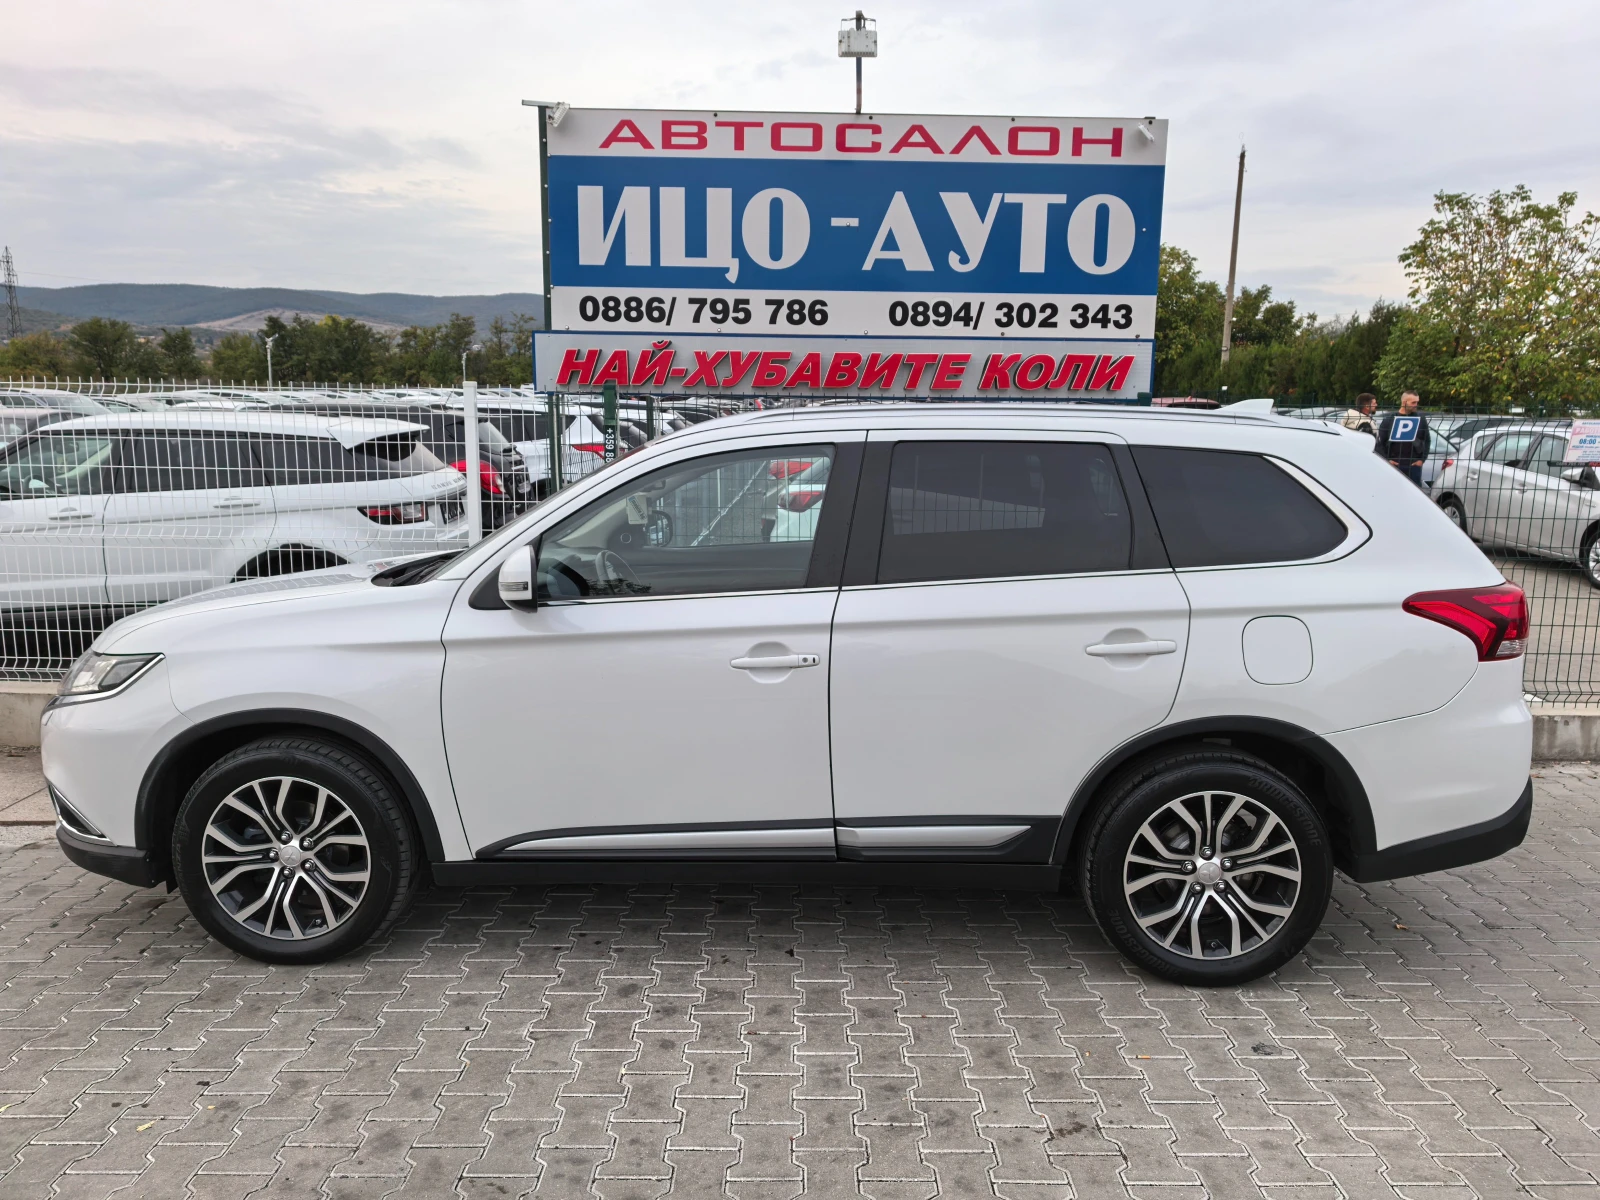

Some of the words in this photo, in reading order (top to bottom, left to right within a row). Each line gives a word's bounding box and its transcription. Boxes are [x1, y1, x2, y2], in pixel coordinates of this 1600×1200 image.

[598, 119, 1123, 157] АВТОСАЛОН
[579, 295, 677, 326] 0886/
[688, 297, 752, 324] 795
[765, 298, 829, 326] 786
[888, 300, 985, 330] 0894/
[994, 301, 1058, 328] 302
[1069, 302, 1133, 329] 343
[556, 340, 972, 391] НАЙ-ХУБАВИТЕ
[978, 352, 1136, 391] КОЛИ
[605, 427, 615, 450] +359
[1395, 419, 1414, 439] P
[1249, 775, 1322, 846] BRIDGESTONE
